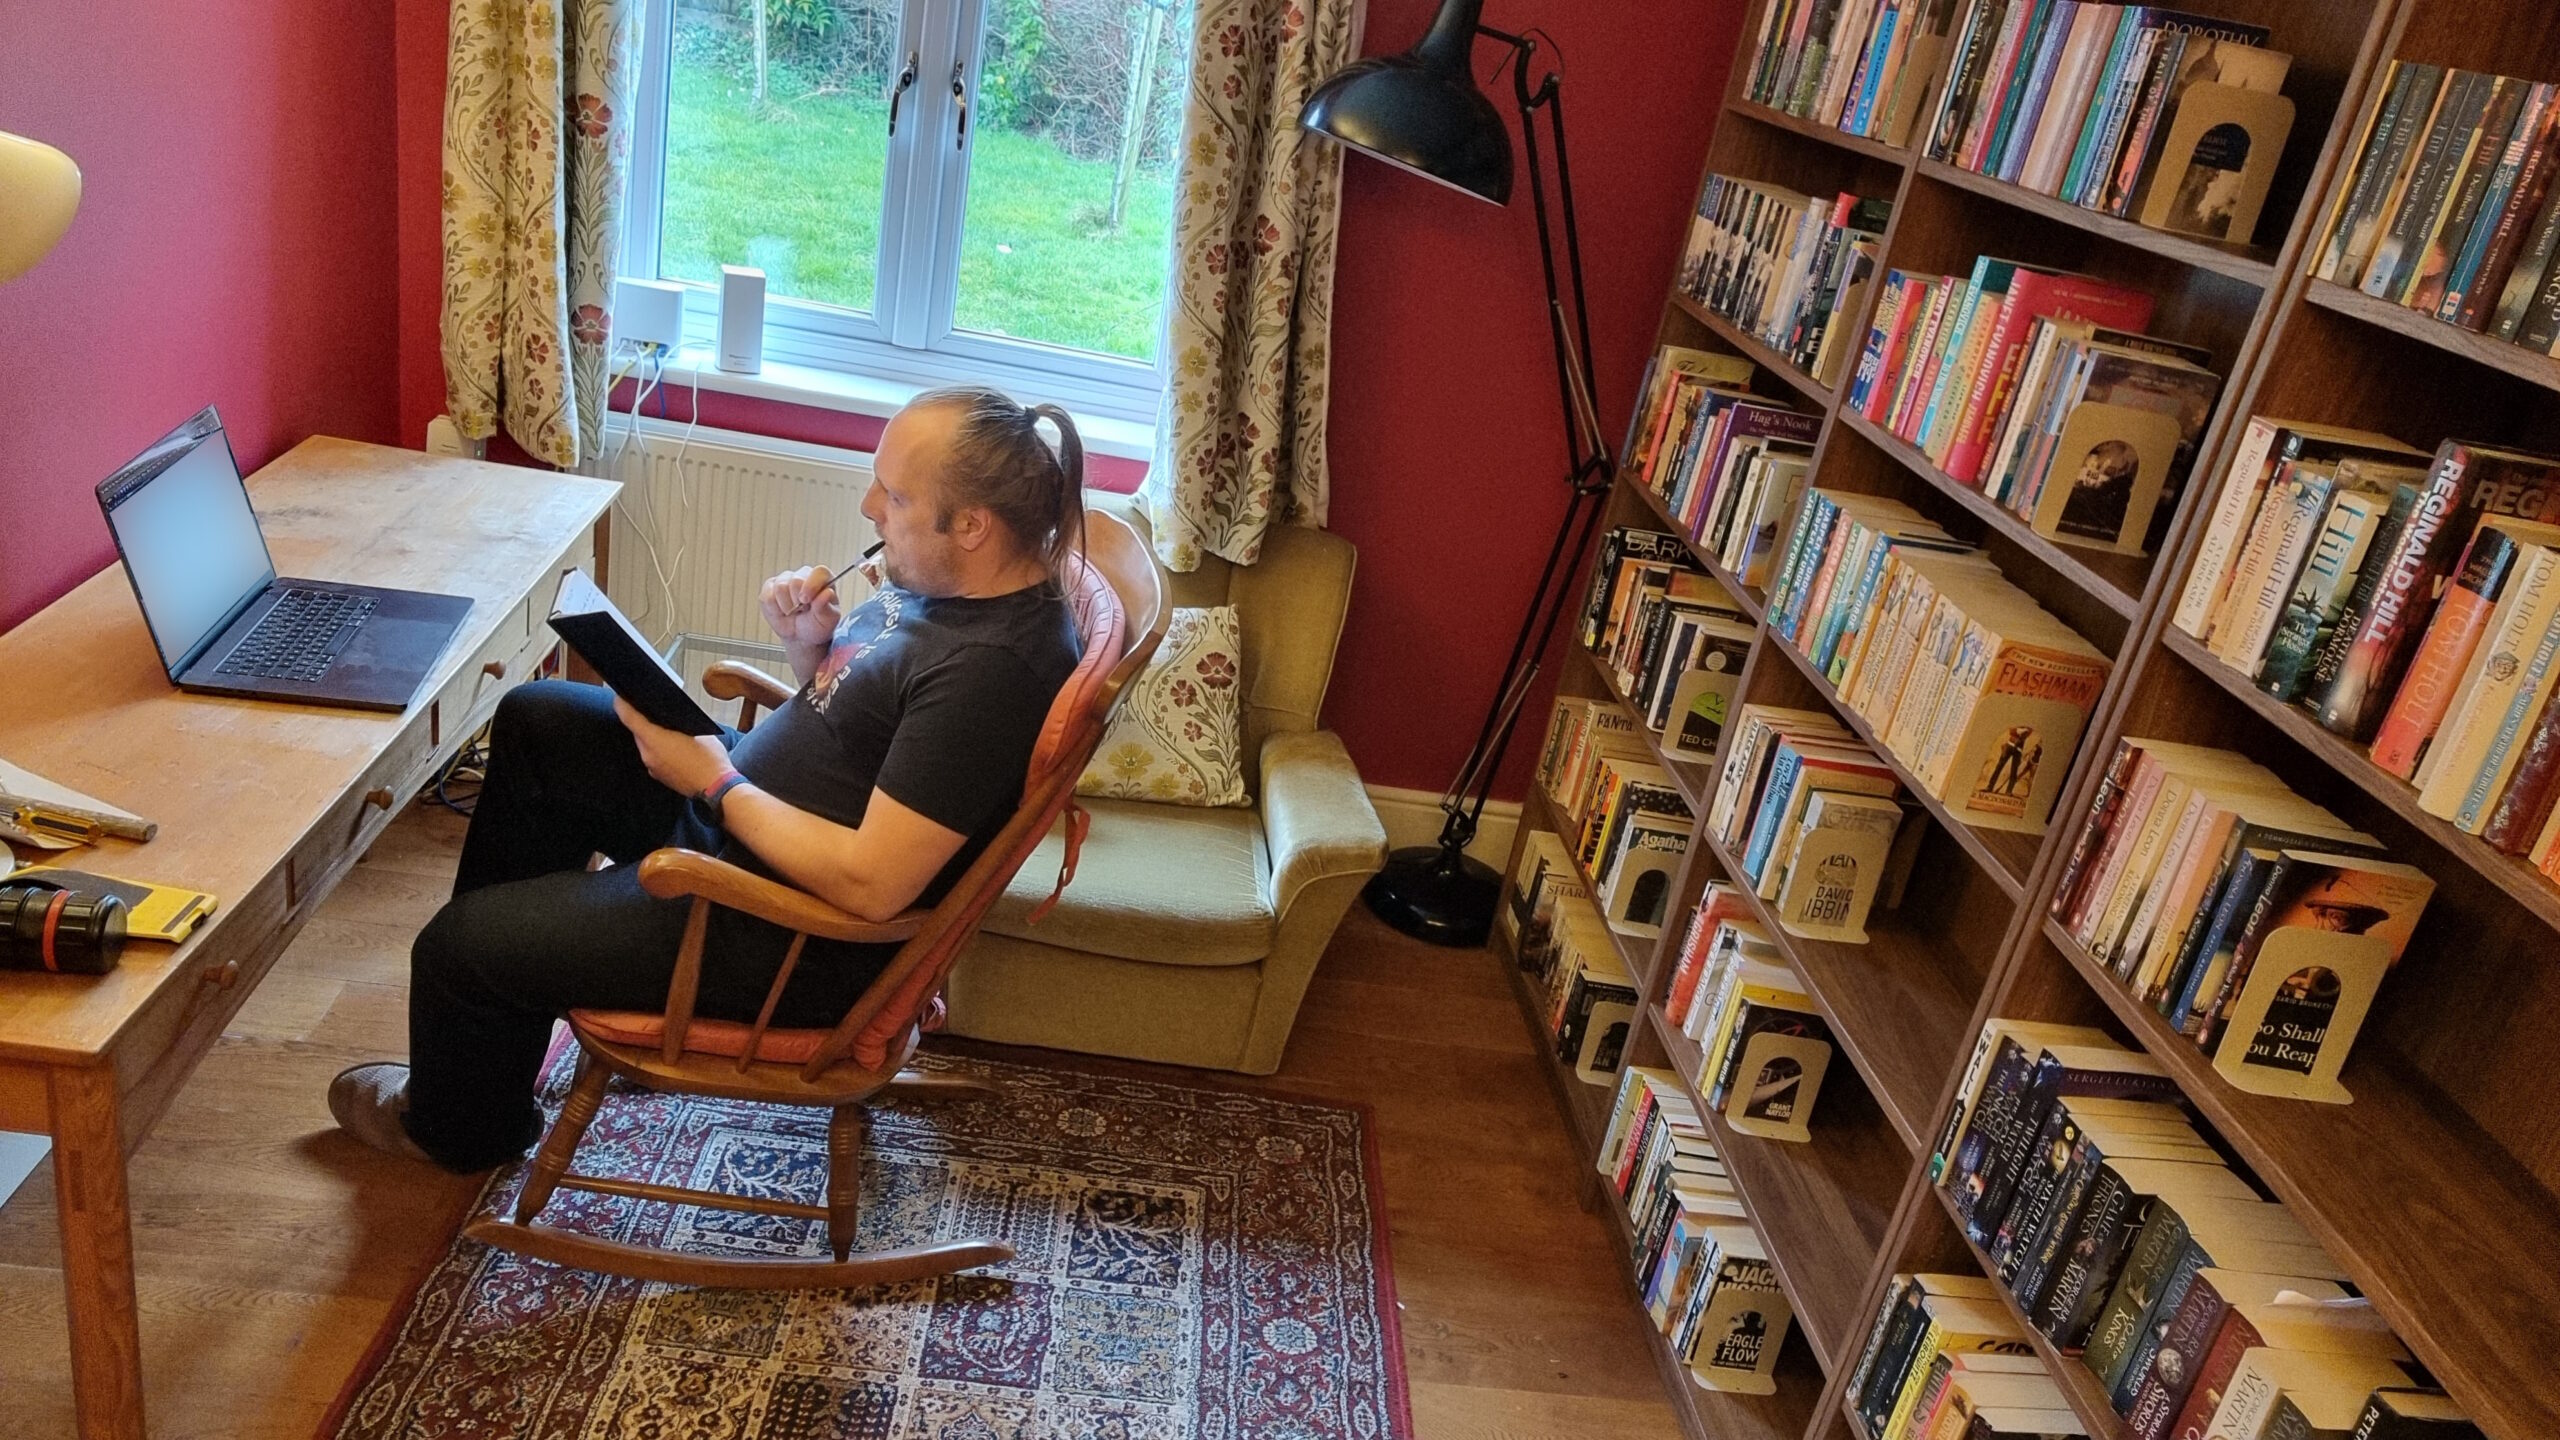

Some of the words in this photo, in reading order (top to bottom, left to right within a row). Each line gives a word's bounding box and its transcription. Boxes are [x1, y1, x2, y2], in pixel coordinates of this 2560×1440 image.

[2508, 148, 2541, 211] REGINALD
[2495, 211, 2515, 240] HILL
[1997, 279, 2022, 322] JANET
[1909, 318, 1940, 379] EVANOVICH
[1970, 324, 2007, 401] EVANOVICH
[1747, 410, 1780, 428] Hag's
[1782, 416, 1813, 431] Nook
[2226, 446, 2259, 503] Reginald
[1793, 495, 1818, 535] JASPER
[2220, 503, 2237, 528] Hill
[2251, 488, 2286, 549] Reginald
[2389, 456, 2464, 594] REGINALD
[2408, 487, 2430, 520] The
[1809, 507, 1835, 551] JASPER
[1825, 521, 1850, 567] JASPER
[1836, 528, 1861, 572] JASPER
[2266, 499, 2311, 576] Reginald
[2308, 499, 2367, 582] Hill
[1778, 536, 1804, 581] FFORDE
[1795, 552, 1820, 596] FFORDE
[1862, 540, 1886, 582] JASPER
[2242, 548, 2263, 577] Hill
[2367, 518, 2416, 612] Woodcutter
[2524, 554, 2557, 600] TOM
[1812, 567, 1836, 610] FFORDE
[1845, 584, 1870, 629] FFORDE
[2255, 574, 2282, 610] Hill
[870, 590, 902, 642] TRUGGLE
[2335, 614, 2361, 661] DEATH
[2362, 589, 2404, 649] HILL
[2430, 595, 2477, 661] TOM
[2501, 598, 2538, 653] HOLT
[2312, 604, 2353, 685] DORMOUSE
[2527, 639, 2554, 678] HOLT
[1997, 661, 2094, 702] FLASHMAN
[2397, 658, 2448, 734] HOLT
[1680, 732, 1700, 744] TED
[2106, 748, 2126, 778] Donna
[2089, 775, 2117, 817] Leon
[2112, 790, 2139, 830] Leon
[2133, 773, 2160, 815] Donna
[2150, 788, 2178, 831] Donna
[1637, 830, 1687, 852] Agatha
[2122, 813, 2142, 843] Leon
[2138, 827, 2160, 858] Leon
[2173, 800, 2199, 842] Donna
[2161, 840, 2182, 871] Leon
[1815, 885, 1855, 901] DAVID
[2141, 874, 2165, 915] ACQUA
[2262, 863, 2284, 897] Donna
[1803, 897, 1851, 921] IBBIN
[2130, 914, 2148, 941] ALTA
[2242, 893, 2273, 939] Leon
[2247, 1043, 2269, 1056] ou
[2277, 1020, 2326, 1044] Shall
[1611, 1092, 1627, 1118] LESS
[1968, 1082, 1998, 1132] WATCH
[1986, 1088, 2017, 1142] WATCH
[1997, 1117, 2025, 1162] WATCH
[2001, 1115, 2040, 1185] TWILIGHT
[2016, 1132, 2050, 1193] WATCH
[2028, 1178, 2056, 1224] SIXTH
[2075, 1173, 2118, 1238] THRONES
[2096, 1188, 2129, 1234] GAME
[2009, 1221, 2038, 1271] WATCH
[2134, 1209, 2179, 1278] MARTIN
[2043, 1256, 2084, 1318] MARTIN
[2065, 1267, 2091, 1305] GEORGE
[2162, 1249, 2205, 1315] MARTIN
[2099, 1305, 2130, 1349] KINGS
[2113, 1318, 2138, 1353] CLASH
[2168, 1281, 2214, 1350] MARTIN
[2191, 1296, 2220, 1340] GEORGE
[1724, 1333, 1764, 1349] EAGLE
[1906, 1330, 1936, 1380] LEIBOWITZ
[2130, 1380, 2167, 1436] SWORDS
[2145, 1401, 2172, 1437] STORM
[2216, 1364, 2263, 1440] MARTIN
[2242, 1380, 2272, 1428] GEORGE
